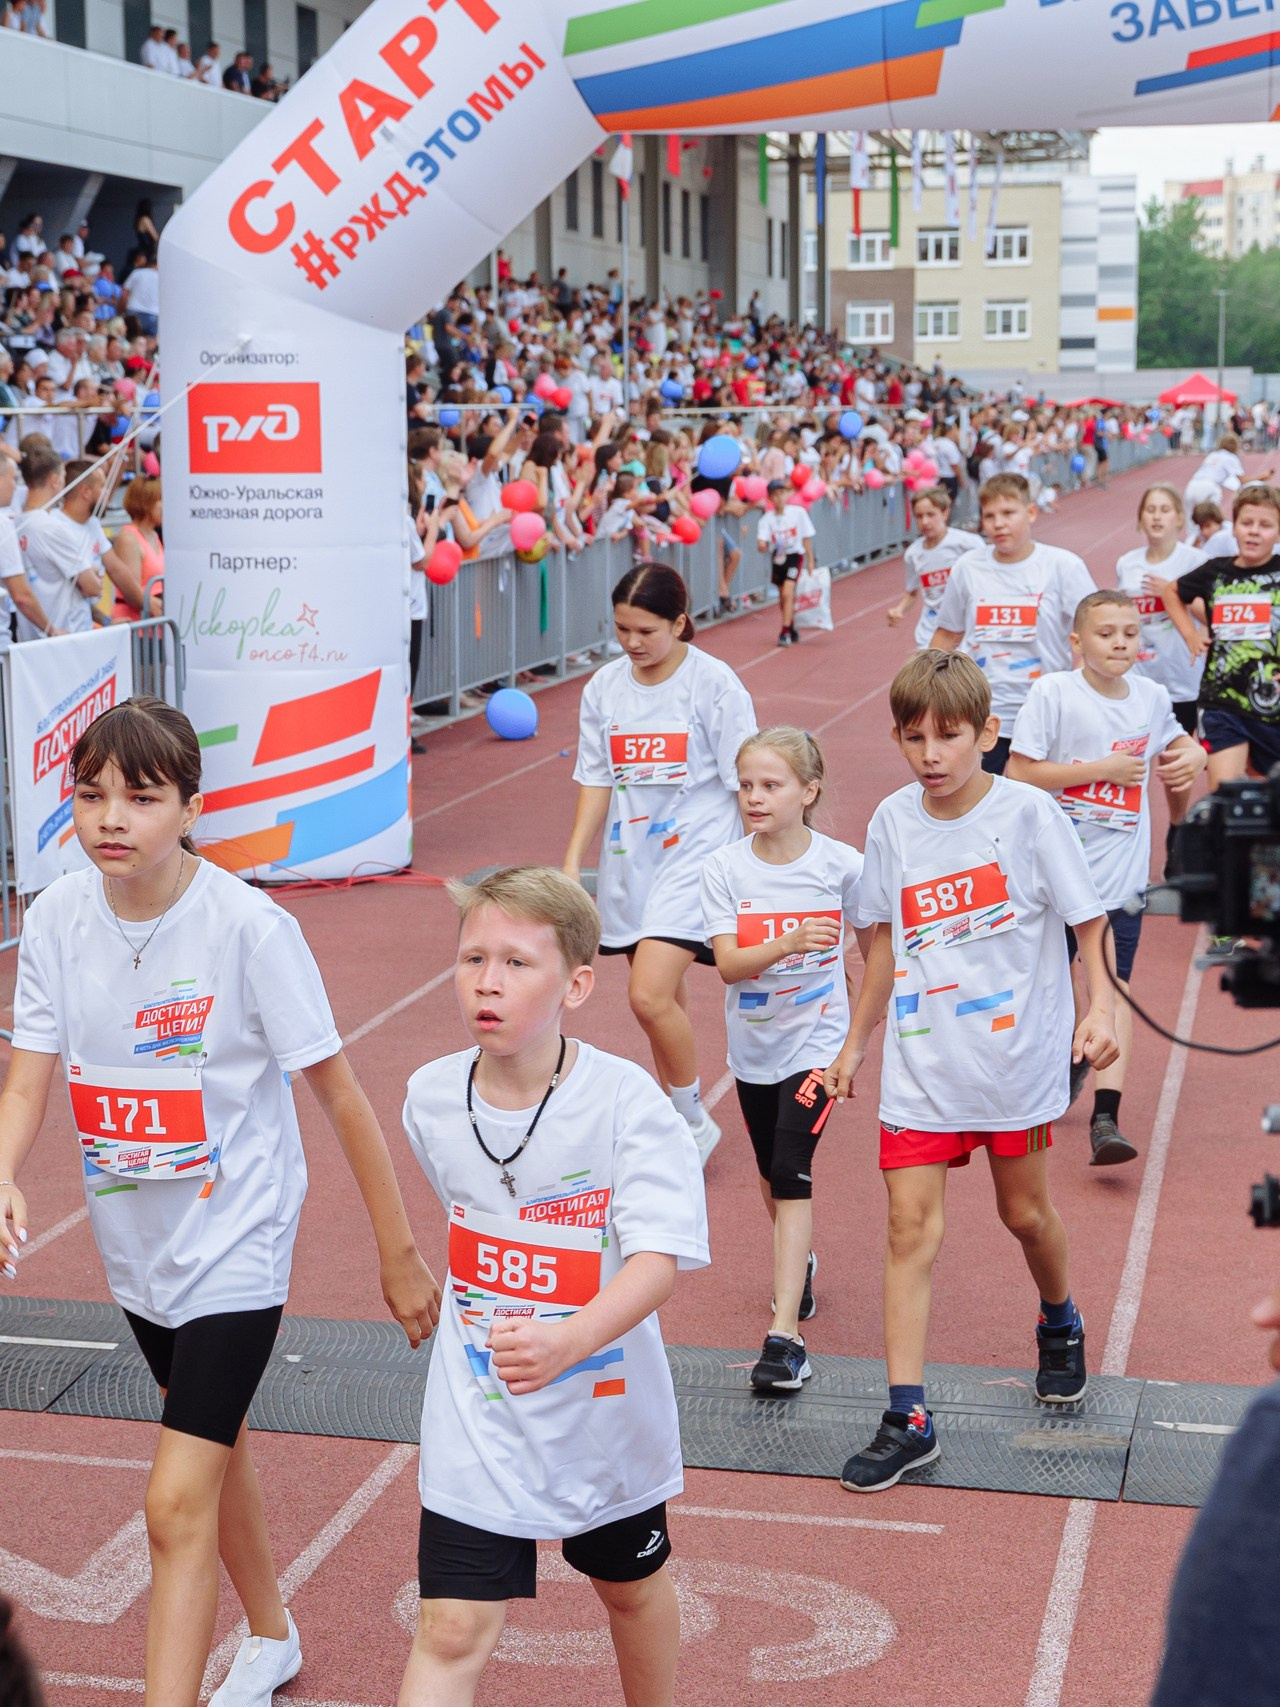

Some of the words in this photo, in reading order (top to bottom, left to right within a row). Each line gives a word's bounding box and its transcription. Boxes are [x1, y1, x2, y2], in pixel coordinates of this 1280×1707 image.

[1110, 0, 1280, 43] ЗАБ
[228, 0, 500, 254] СТАРТ
[199, 350, 299, 367] Организатор:
[189, 485, 323, 503] Южно-Уральская
[190, 506, 259, 520] железная
[263, 507, 323, 522] дорога
[209, 552, 298, 574] Партнер:
[989, 607, 1022, 625] 131
[1135, 598, 1156, 612] 77
[1222, 605, 1256, 622] 574
[249, 642, 349, 663] onco74.ru
[624, 737, 666, 760] 572
[1083, 782, 1126, 805] 141
[915, 876, 974, 918] 587
[762, 917, 816, 944] 18
[141, 1000, 208, 1026] ДОСТИГАЯ
[97, 1095, 167, 1135] 171
[524, 1192, 604, 1221] ДОСТИГАЯ
[477, 1242, 557, 1294] 585
